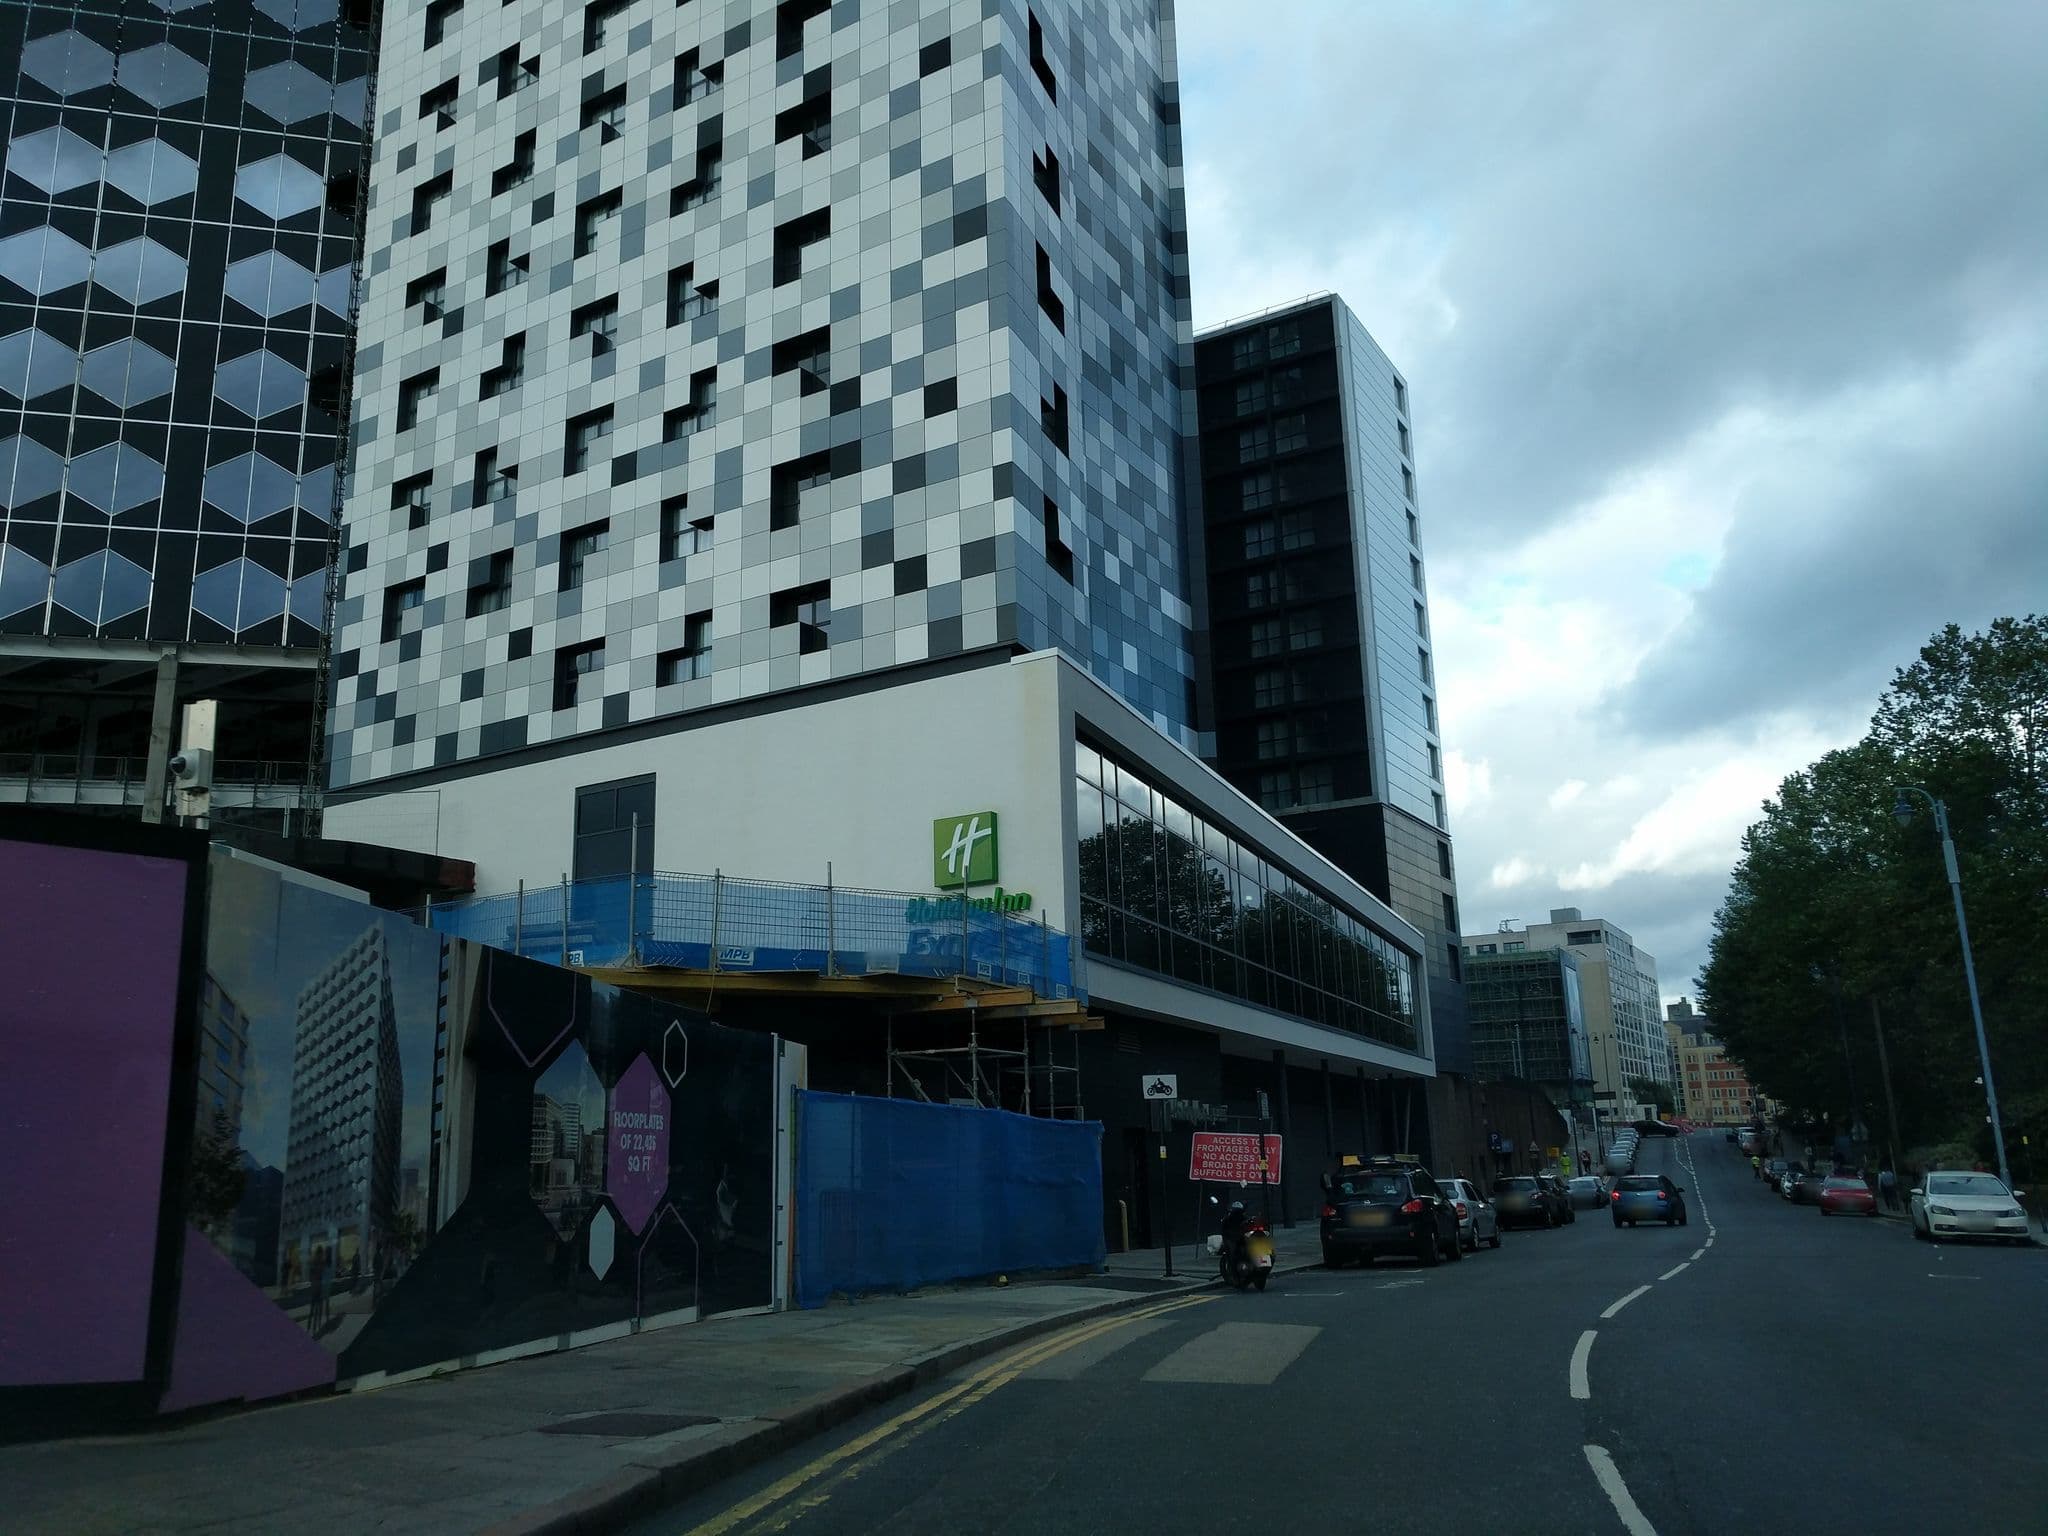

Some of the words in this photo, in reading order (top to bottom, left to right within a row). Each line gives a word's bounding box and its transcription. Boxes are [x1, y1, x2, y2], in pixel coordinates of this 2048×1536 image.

[992, 886, 1032, 914] Inn
[719, 949, 750, 960] MPB
[613, 1111, 664, 1130] FLOORPLATES
[620, 1133, 632, 1149] OF
[1213, 1137, 1249, 1145] ACCESS
[1250, 1138, 1262, 1146] TO
[1196, 1144, 1250, 1154] FRONTAGES
[1252, 1146, 1277, 1154] OLY
[1202, 1152, 1217, 1160] NO
[1219, 1153, 1255, 1162] ACCESS
[627, 1155, 640, 1172] SQ
[642, 1155, 651, 1172] FT
[1201, 1160, 1233, 1169] BROAD
[1235, 1162, 1248, 1170] ST
[1249, 1163, 1269, 1171] AND
[1193, 1168, 1233, 1178] SUFFOLK
[1235, 1170, 1248, 1178] ST
